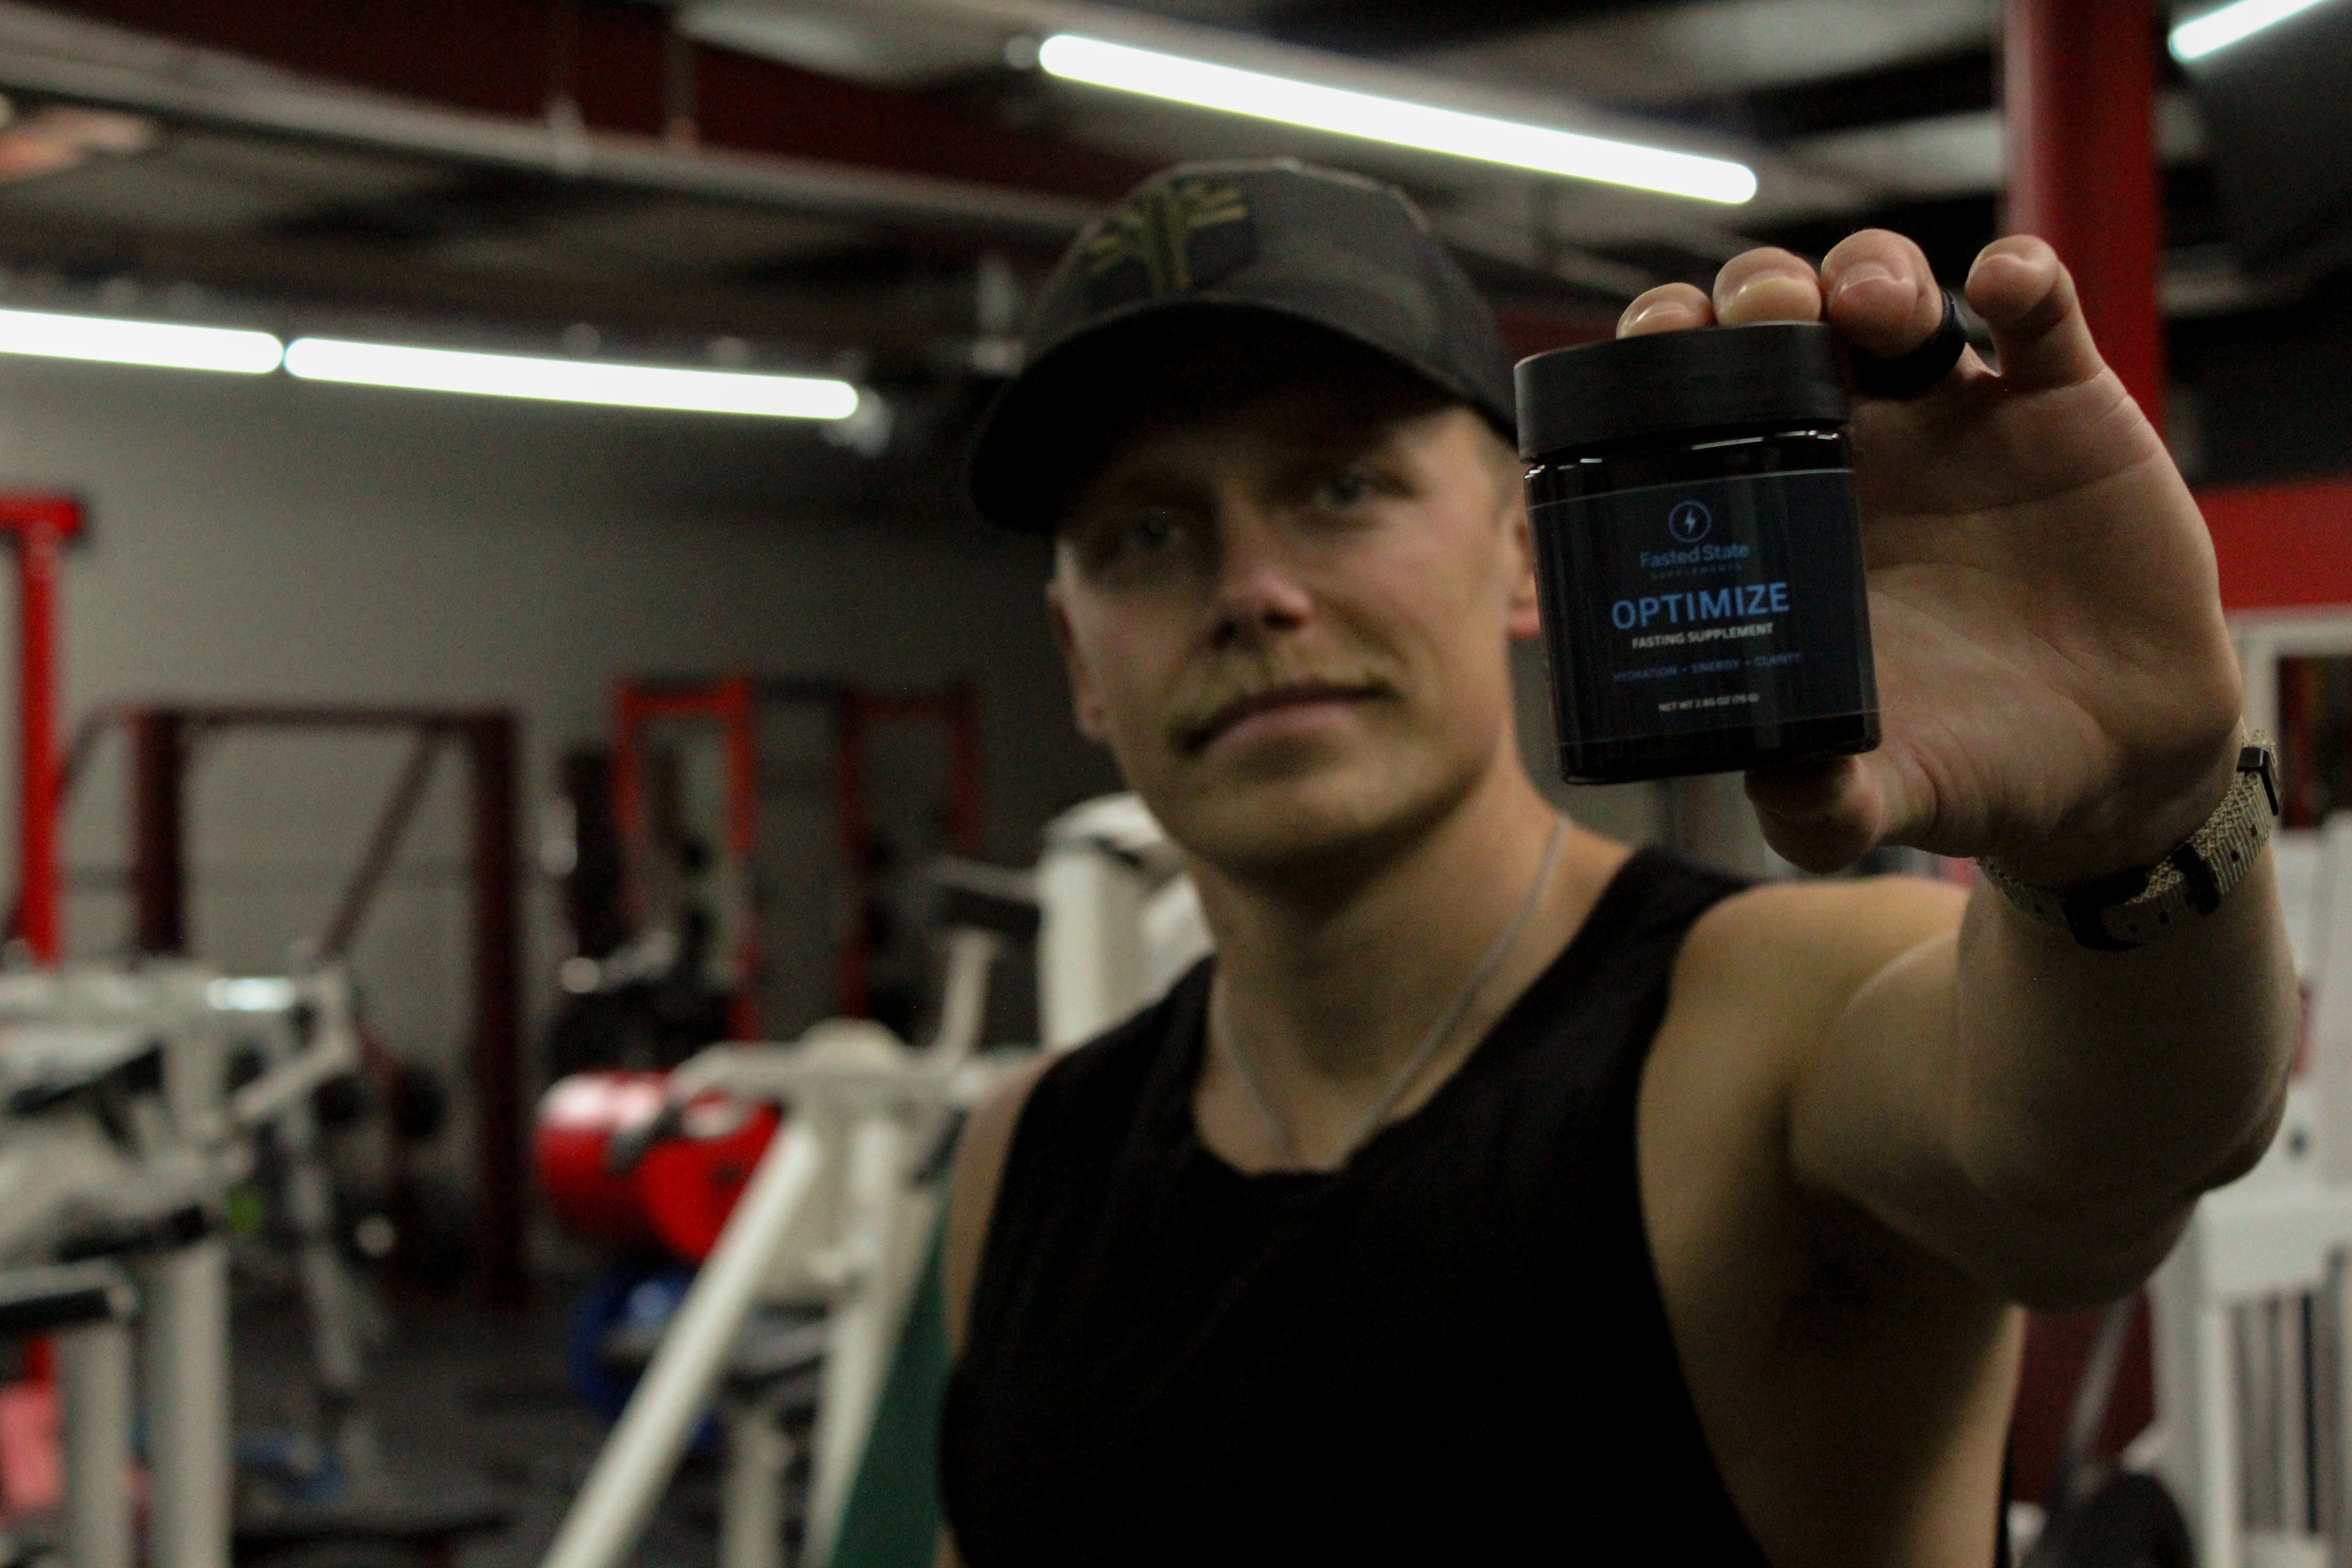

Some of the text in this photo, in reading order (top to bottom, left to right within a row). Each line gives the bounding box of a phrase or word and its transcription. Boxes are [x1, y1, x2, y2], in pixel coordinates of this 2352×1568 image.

[1640, 543, 1751, 568] Fasted State
[1611, 582, 1790, 630] OPTIMIZE
[1632, 622, 1774, 649] FASTING SUPPLEMENT
